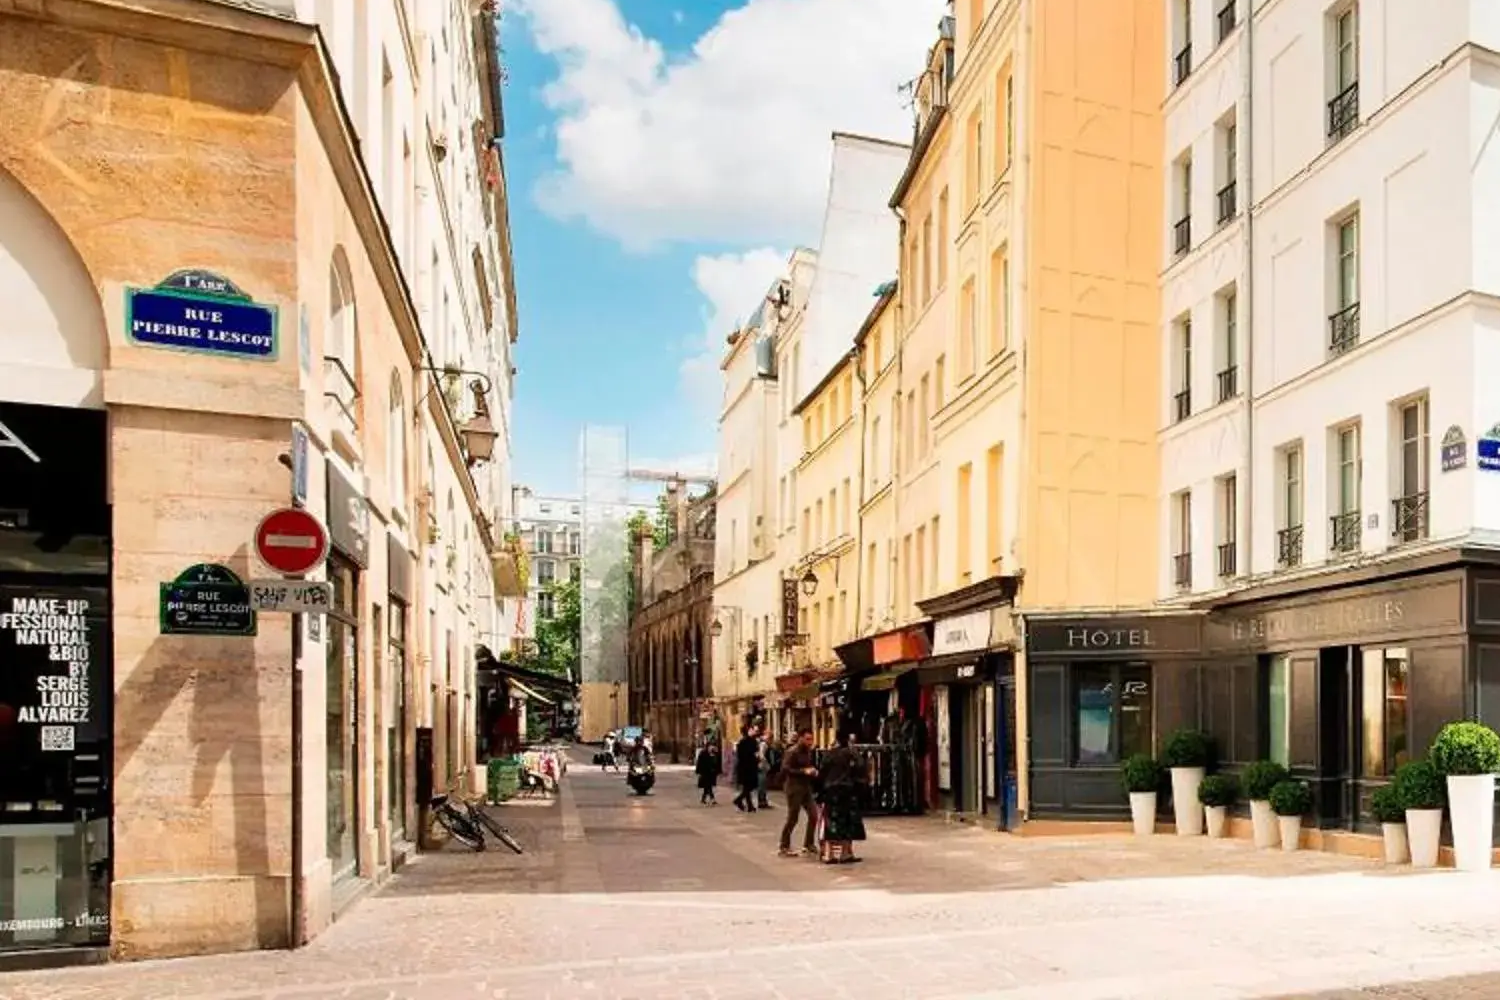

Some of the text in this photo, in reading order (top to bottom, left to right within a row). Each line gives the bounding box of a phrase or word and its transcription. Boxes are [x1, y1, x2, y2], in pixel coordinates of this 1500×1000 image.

[184, 307, 223, 323] RUE
[133, 319, 272, 347] PIERRE LESCOT
[197, 591, 220, 601] RUE
[12, 598, 89, 614] MAKE-UP
[209, 604, 249, 614] LESCOT
[0, 613, 90, 631] FESSIONAL
[16, 630, 90, 646] NATURAL
[49, 646, 89, 661] &BIO
[69, 661, 89, 677] BY
[37, 676, 89, 692] SERGE
[41, 692, 89, 707] LOUIS
[17, 706, 89, 723] ALVAREZ
